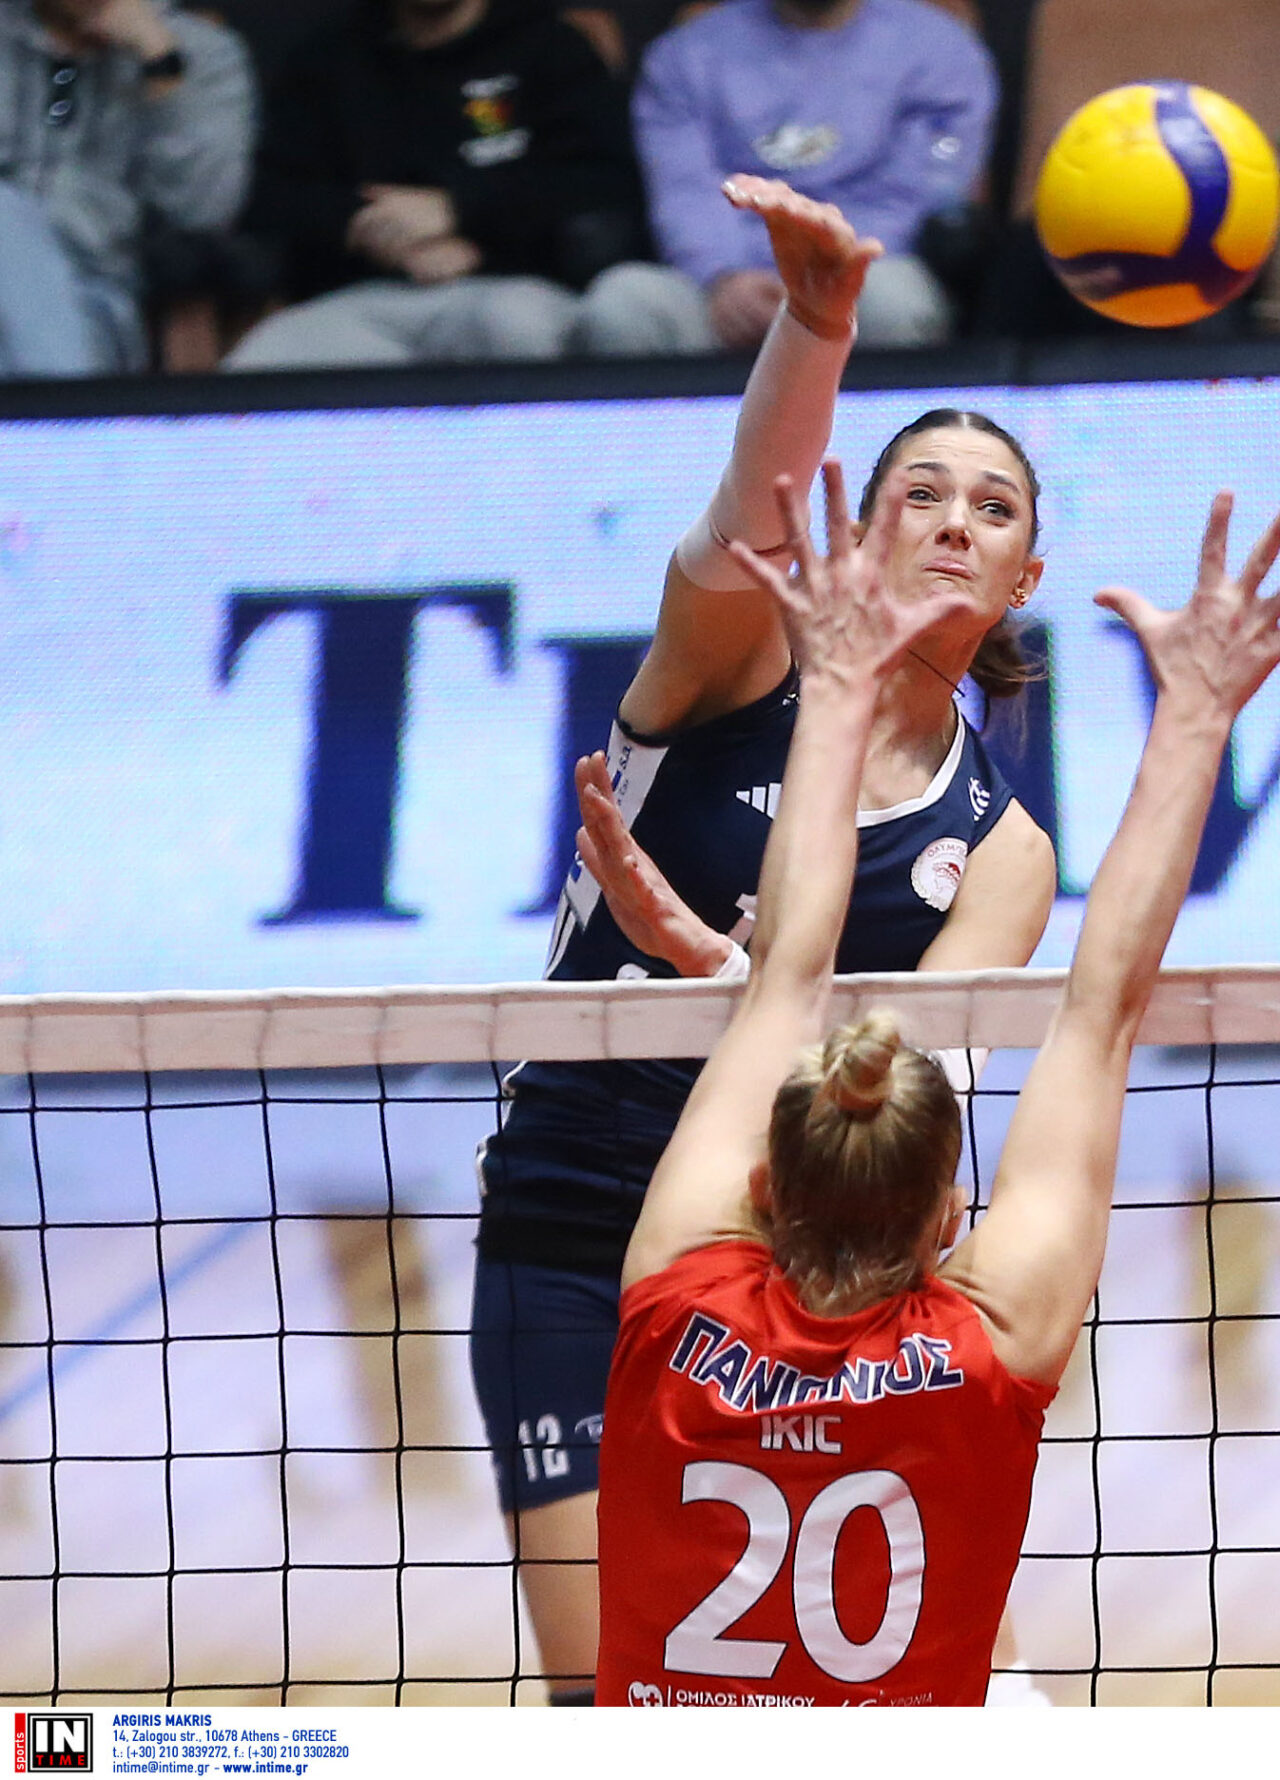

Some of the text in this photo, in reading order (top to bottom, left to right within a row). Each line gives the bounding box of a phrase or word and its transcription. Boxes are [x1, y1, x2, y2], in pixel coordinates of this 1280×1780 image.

[518, 1413, 570, 1483] 12
[760, 1414, 842, 1454] IKIC
[663, 1460, 927, 1684] 20
